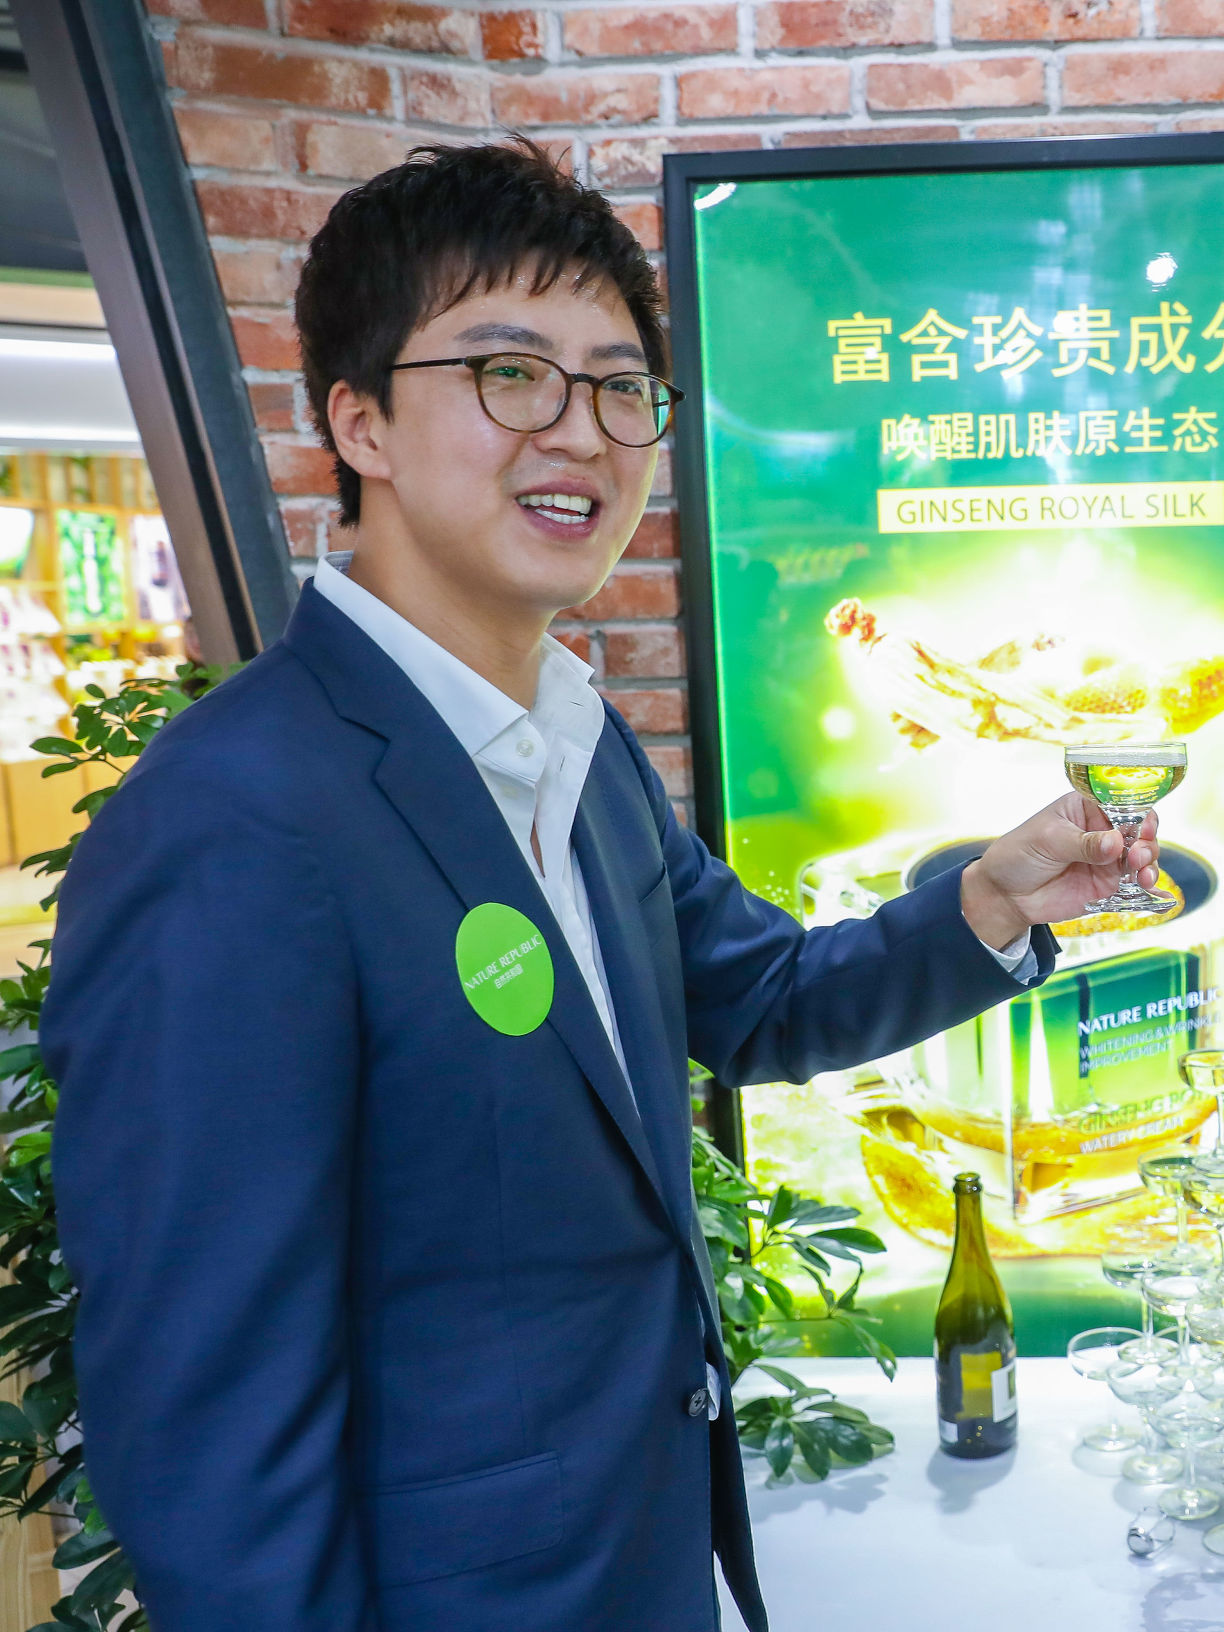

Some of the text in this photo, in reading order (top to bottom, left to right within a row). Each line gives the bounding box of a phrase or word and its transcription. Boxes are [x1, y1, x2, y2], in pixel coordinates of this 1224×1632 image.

[880, 405, 1219, 461] 唤醒肌肤原生态
[896, 492, 1208, 524] GINSENG ROYAL SILK
[464, 934, 542, 992] NATURE REPUBLIC
[1077, 986, 1222, 1036] NATURE REPUBLIC
[1080, 1039, 1174, 1073] IMPROVEMENT
[1079, 1127, 1135, 1154] WATERY
